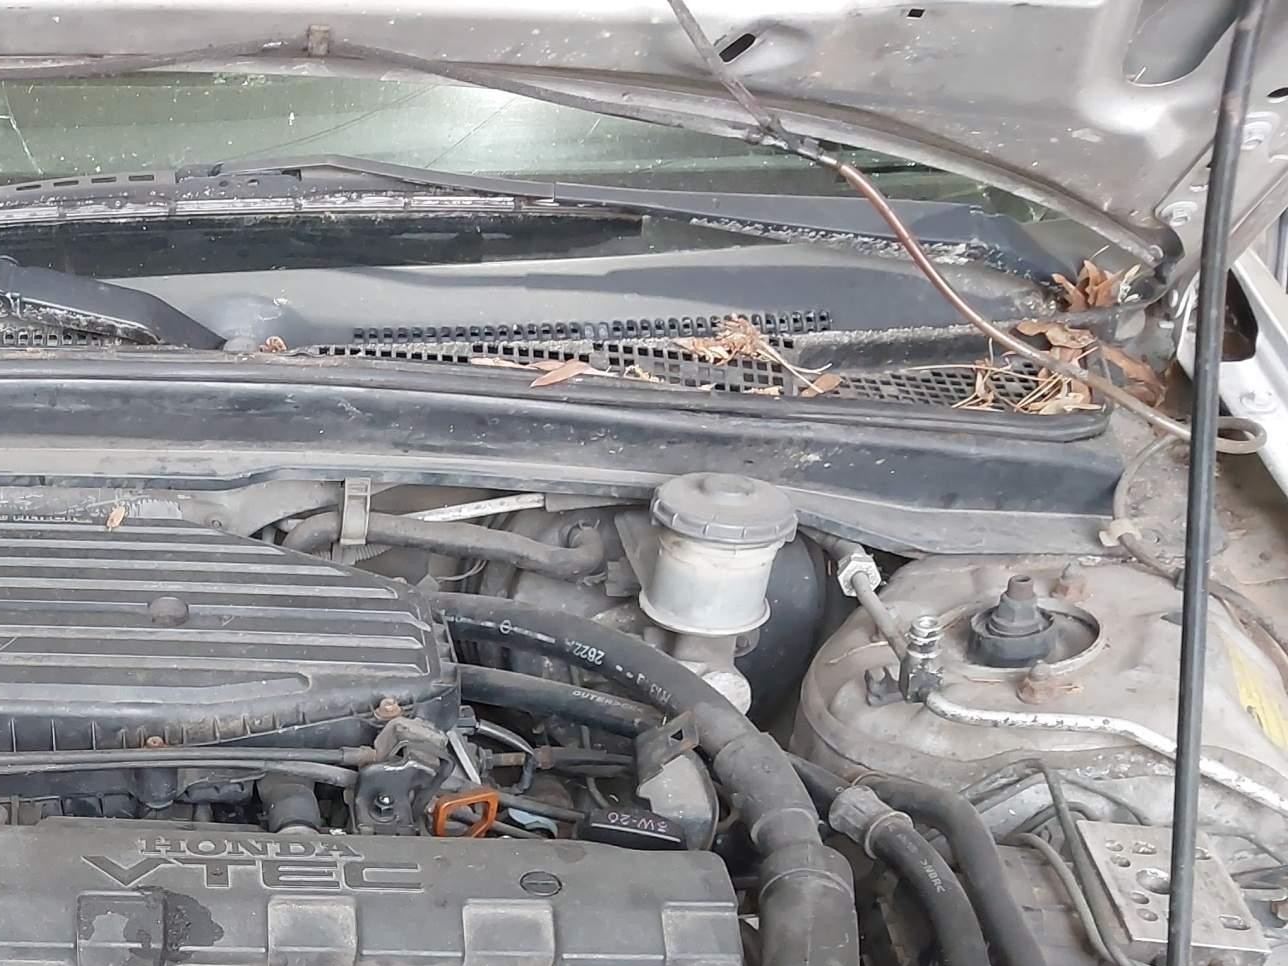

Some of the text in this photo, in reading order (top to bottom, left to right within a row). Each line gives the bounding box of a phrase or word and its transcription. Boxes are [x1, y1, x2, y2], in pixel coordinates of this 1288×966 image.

[607, 811, 668, 833] 5W-20
[137, 837, 365, 860] HONDA
[80, 854, 425, 893] VTEC
